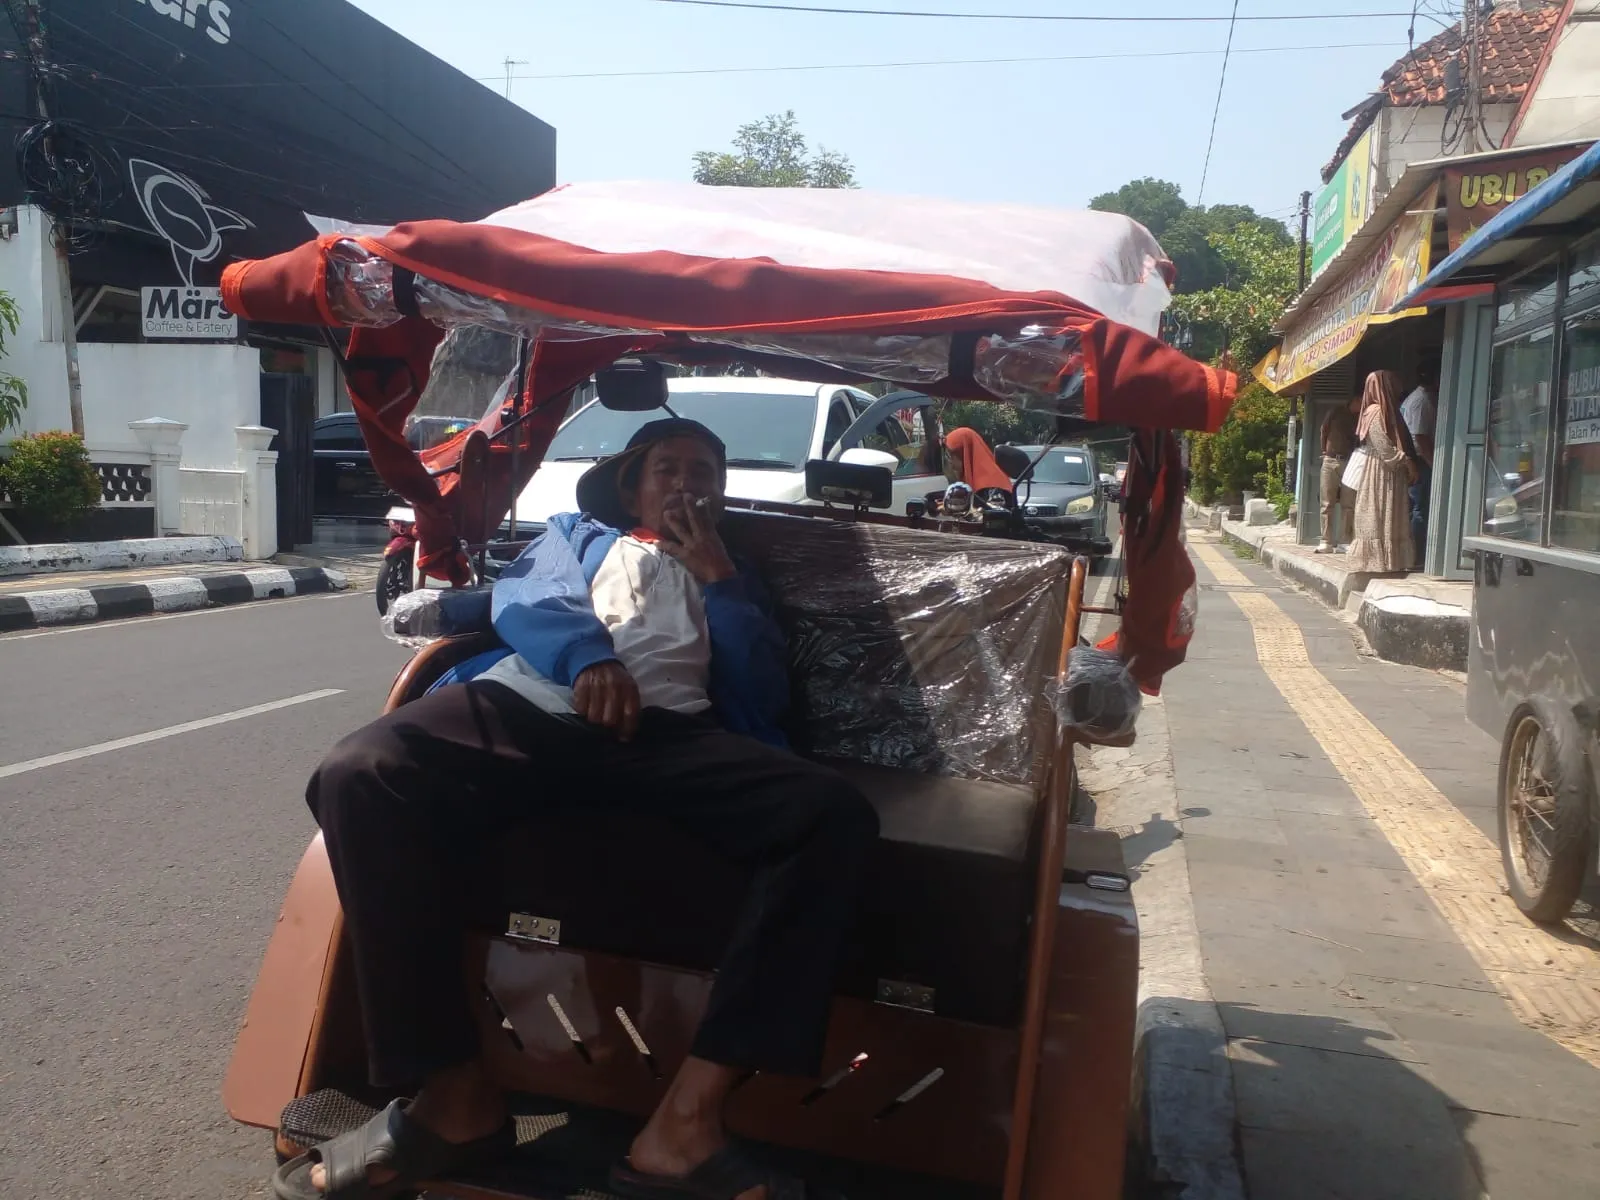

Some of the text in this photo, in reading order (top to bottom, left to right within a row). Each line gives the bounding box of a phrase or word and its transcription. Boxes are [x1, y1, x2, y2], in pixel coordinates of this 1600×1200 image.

[1460, 170, 1516, 208] UBI
[146, 320, 232, 335] Coffee & Eatery
[1568, 424, 1588, 441] Jalan
